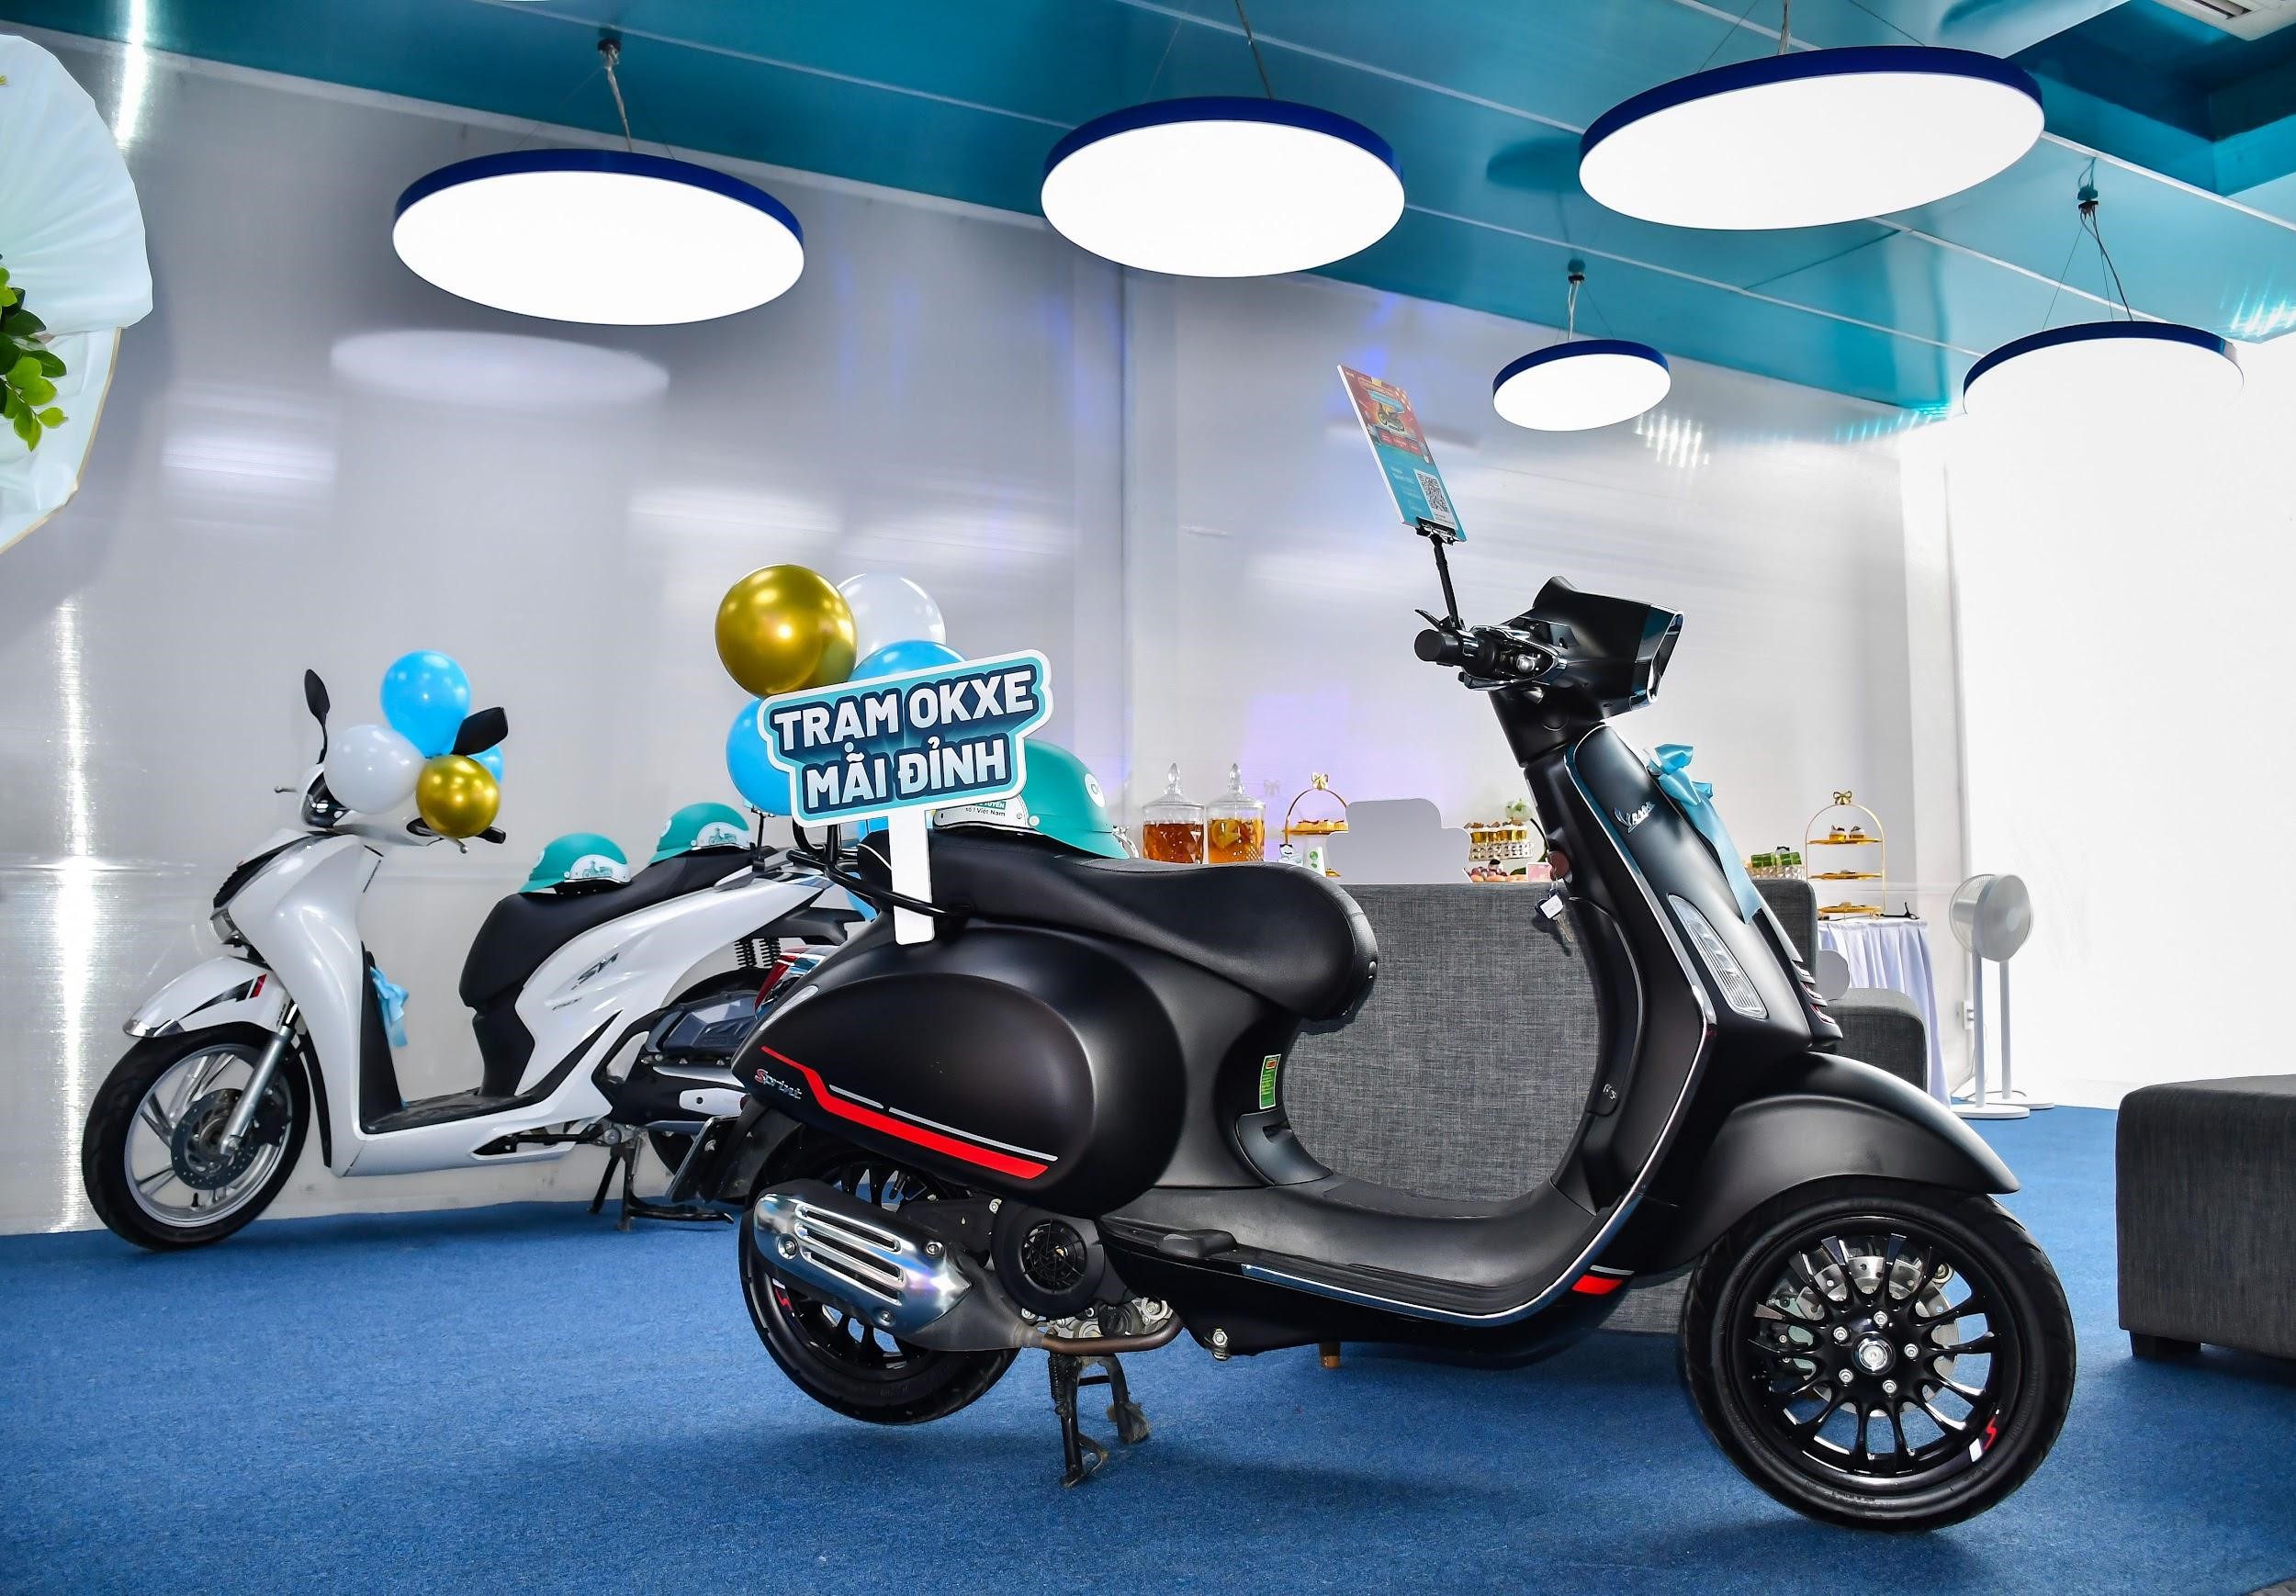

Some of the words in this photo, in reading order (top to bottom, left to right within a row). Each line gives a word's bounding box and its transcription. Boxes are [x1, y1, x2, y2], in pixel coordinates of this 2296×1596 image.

[774, 693, 899, 752] TRẠM
[908, 669, 1034, 729] OKXE
[806, 751, 887, 809] MÃI
[897, 736, 1007, 795] ĐỈNH
[754, 1068, 804, 1100] Sprint
